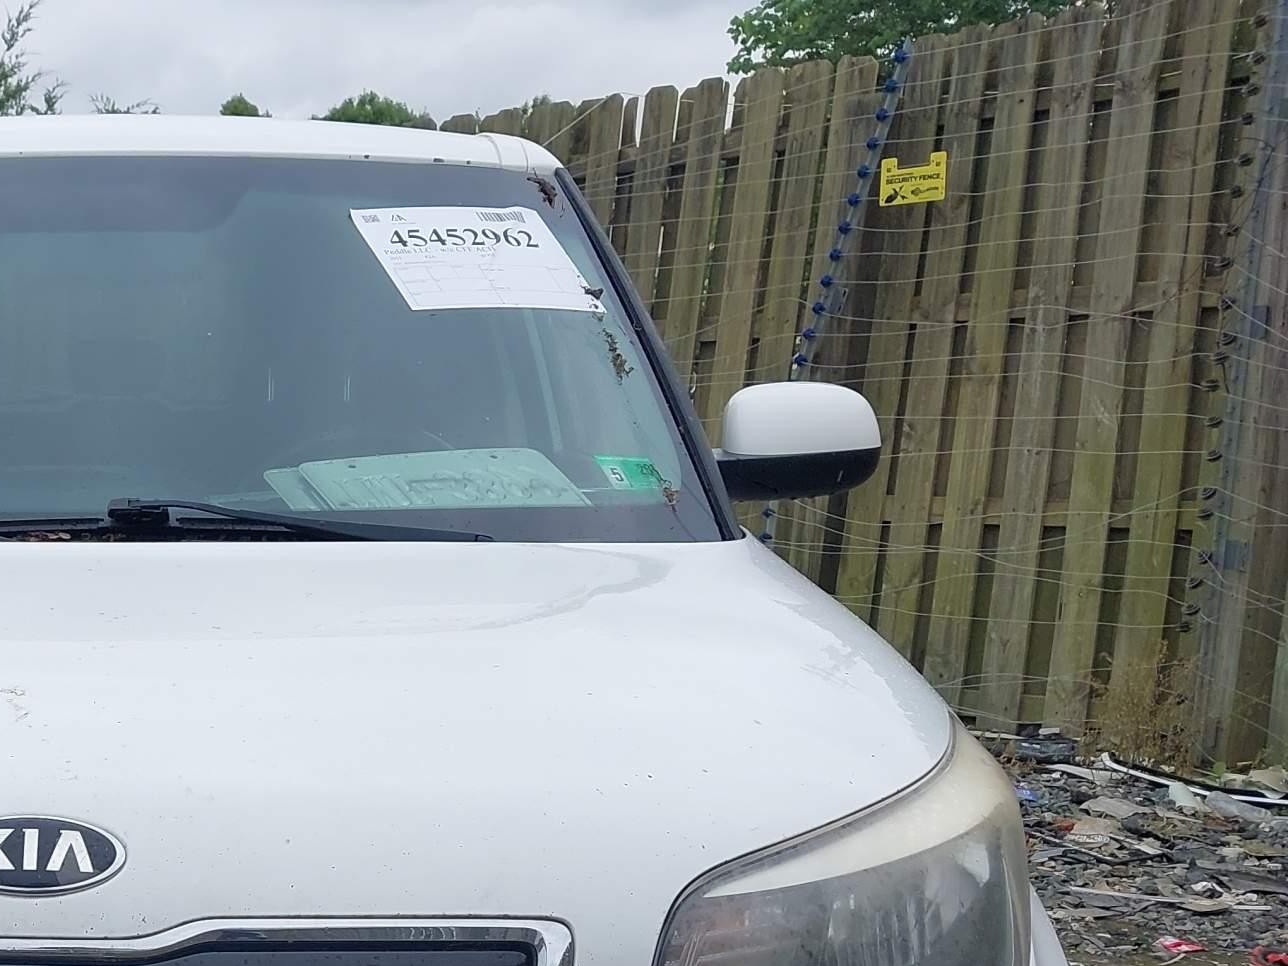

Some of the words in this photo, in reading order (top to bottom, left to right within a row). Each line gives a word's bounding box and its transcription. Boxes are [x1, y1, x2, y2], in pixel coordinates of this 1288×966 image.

[886, 176, 918, 185] SECURITY
[919, 173, 939, 181] FENCE
[390, 228, 539, 248] 45452962
[610, 468, 624, 482] 5
